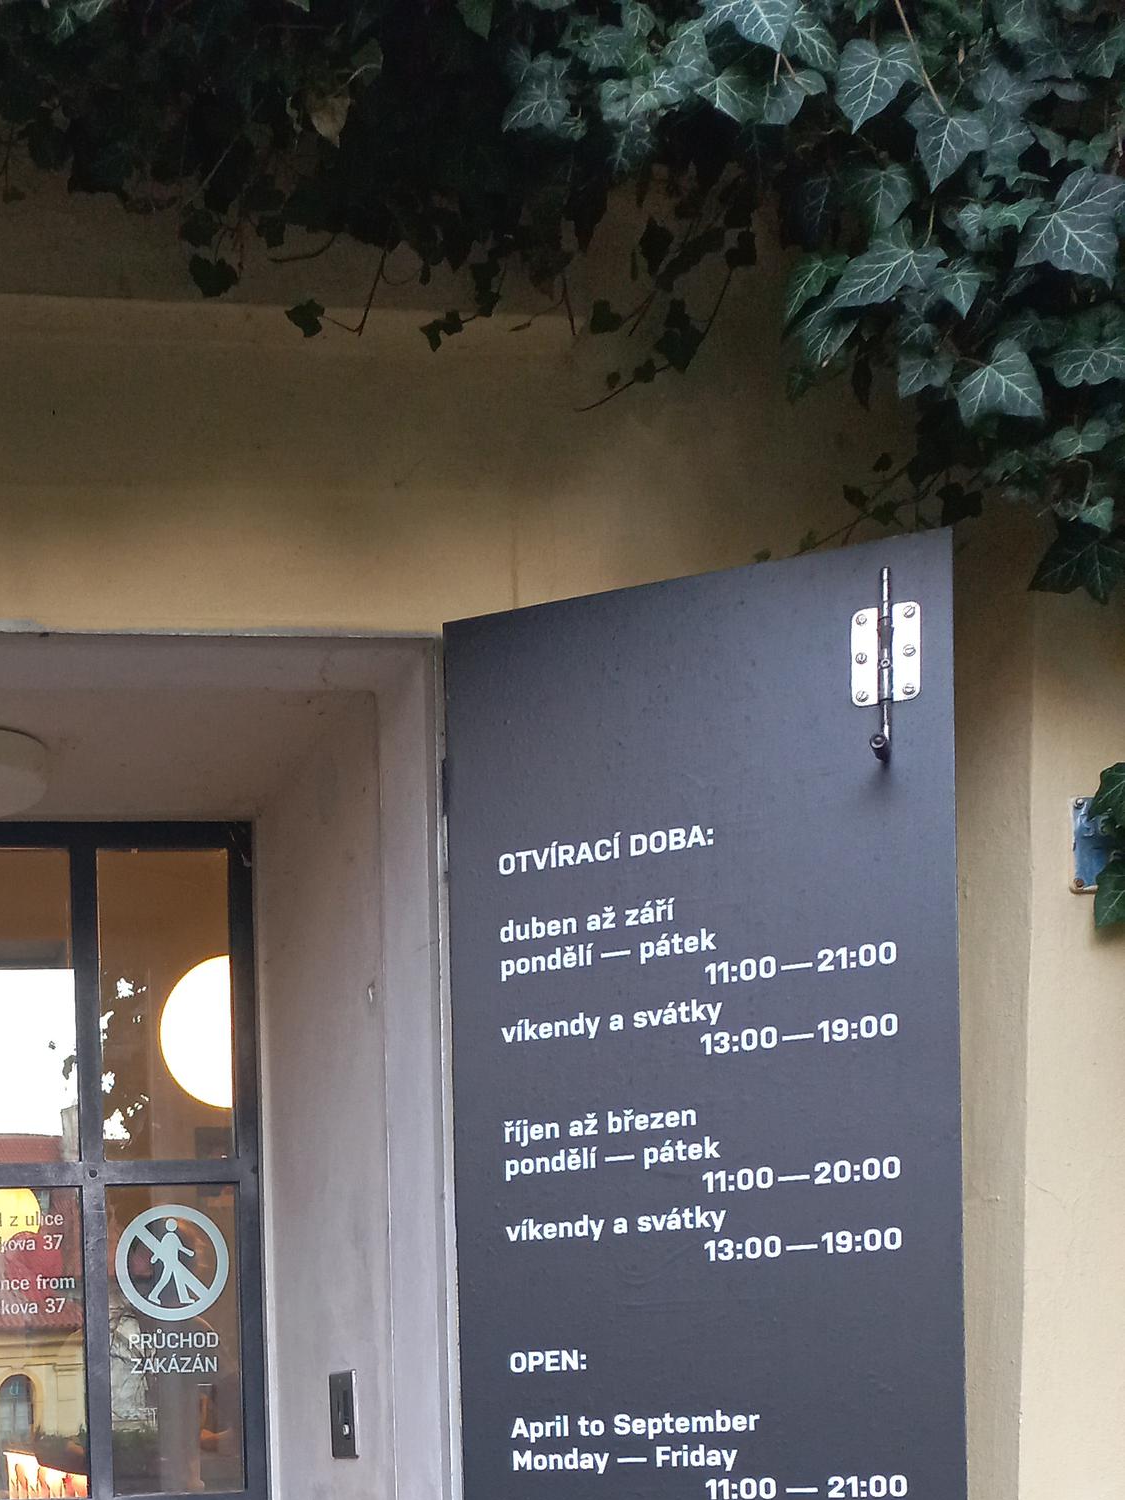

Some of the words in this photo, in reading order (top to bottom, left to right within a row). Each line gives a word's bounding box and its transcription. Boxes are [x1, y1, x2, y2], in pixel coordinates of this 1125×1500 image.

[498, 831, 621, 875] OTVÍRACÍ
[629, 824, 714, 857] DOBA:
[499, 916, 577, 943] duben
[586, 905, 616, 932] až
[624, 897, 675, 927] září
[500, 942, 594, 982] pondělí
[639, 927, 717, 965] pátek
[500, 1012, 601, 1043] víkendy
[609, 1014, 624, 1031] a
[633, 998, 723, 1029] svátky
[503, 1119, 560, 1148] říjen
[568, 1112, 599, 1137] až
[607, 1108, 697, 1134] březen
[505, 1146, 598, 1182] pondělí
[643, 1135, 721, 1170] pátek
[9, 1215, 19, 1227] z
[25, 1210, 64, 1227] ulice
[505, 1214, 605, 1242] víkendy
[613, 1217, 628, 1234] a
[637, 1205, 727, 1233] svátky
[43, 1234, 64, 1250] 37
[36, 1274, 75, 1290] from
[45, 1298, 66, 1313] 37
[128, 1328, 219, 1349] PRŮCHOD
[130, 1353, 218, 1374] ZAKÁZÁN
[509, 1349, 587, 1373] OPEN:
[510, 1414, 569, 1443] April
[577, 1415, 605, 1437] to
[613, 1409, 761, 1440] September
[512, 1447, 610, 1475] Monday
[655, 1443, 738, 1472] Friday
